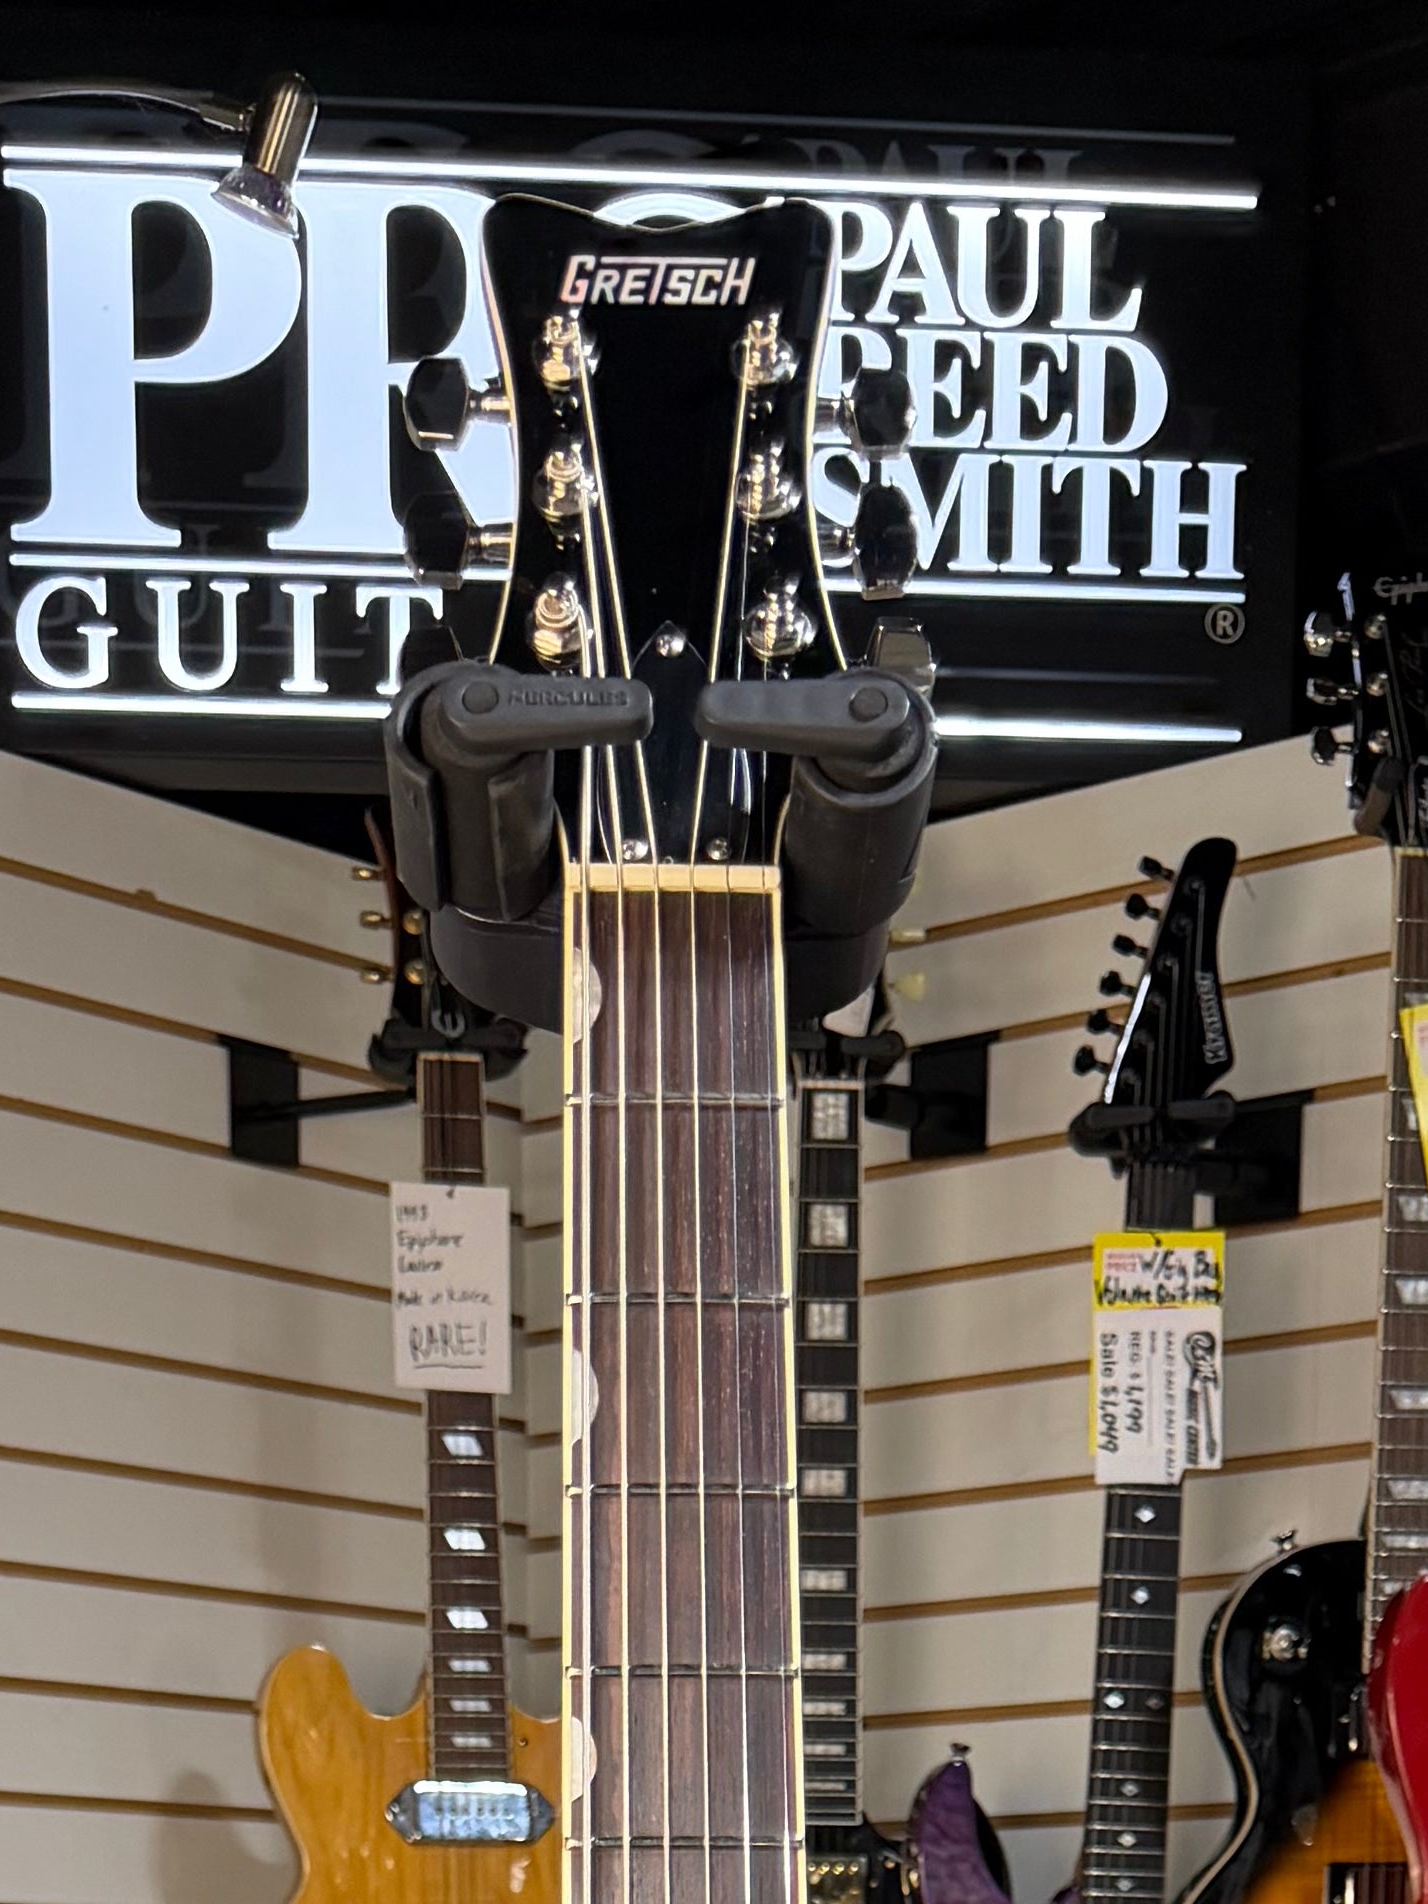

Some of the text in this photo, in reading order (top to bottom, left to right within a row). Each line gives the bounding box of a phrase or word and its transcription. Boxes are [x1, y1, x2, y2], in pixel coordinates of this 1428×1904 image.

[559, 254, 756, 306] GRETSCH
[830, 200, 1144, 332] PAUL
[11, 575, 443, 695] GUIT
[410, 1320, 487, 1362] RARE!
[1099, 1333, 1119, 1378] Sale
